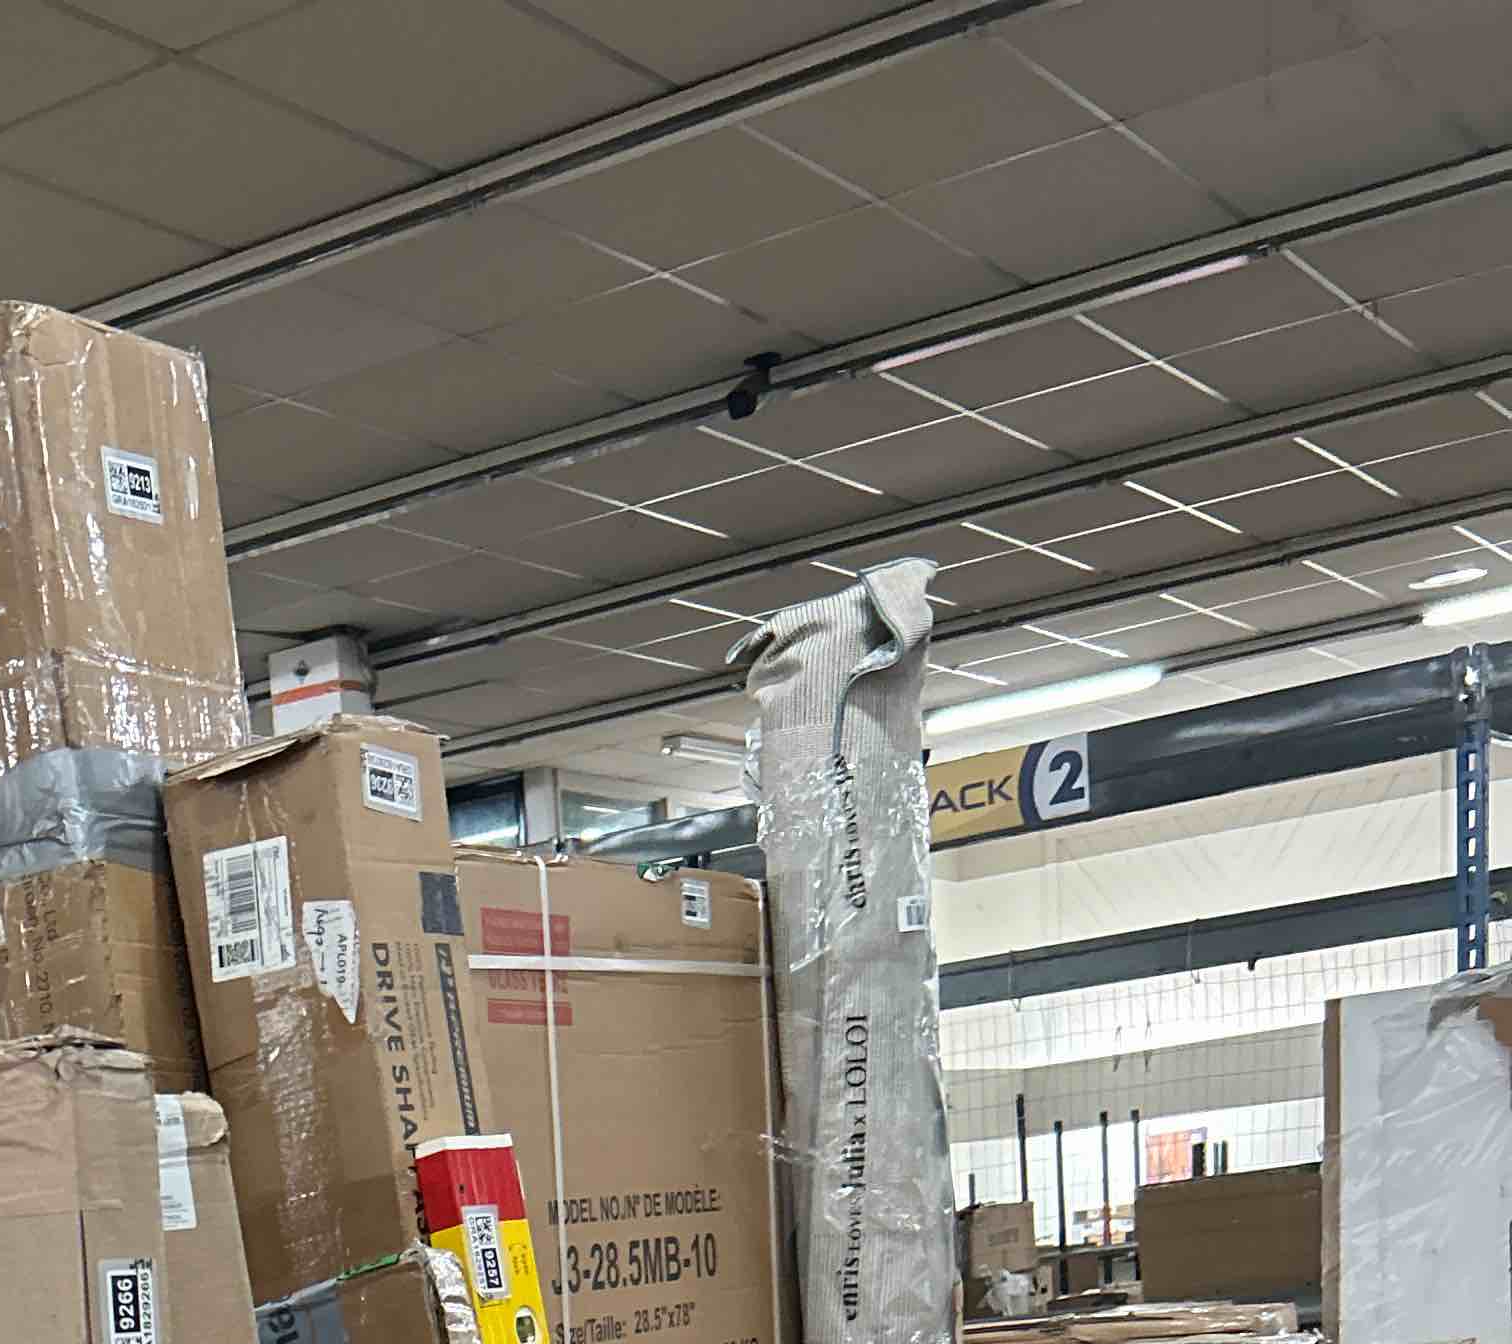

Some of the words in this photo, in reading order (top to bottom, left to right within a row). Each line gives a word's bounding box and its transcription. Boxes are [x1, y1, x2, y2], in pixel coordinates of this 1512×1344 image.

[128, 470, 152, 495] 9213
[929, 775, 1013, 816] ACK
[1049, 750, 1085, 805] 2
[372, 943, 405, 1052] DRIVE
[392, 1064, 419, 1171] SHA
[845, 1015, 868, 1107] LOLOI
[854, 1113, 867, 1126] x
[644, 1192, 663, 1218] DE
[483, 1250, 501, 1287] 9257
[115, 1278, 137, 1331] 9266
